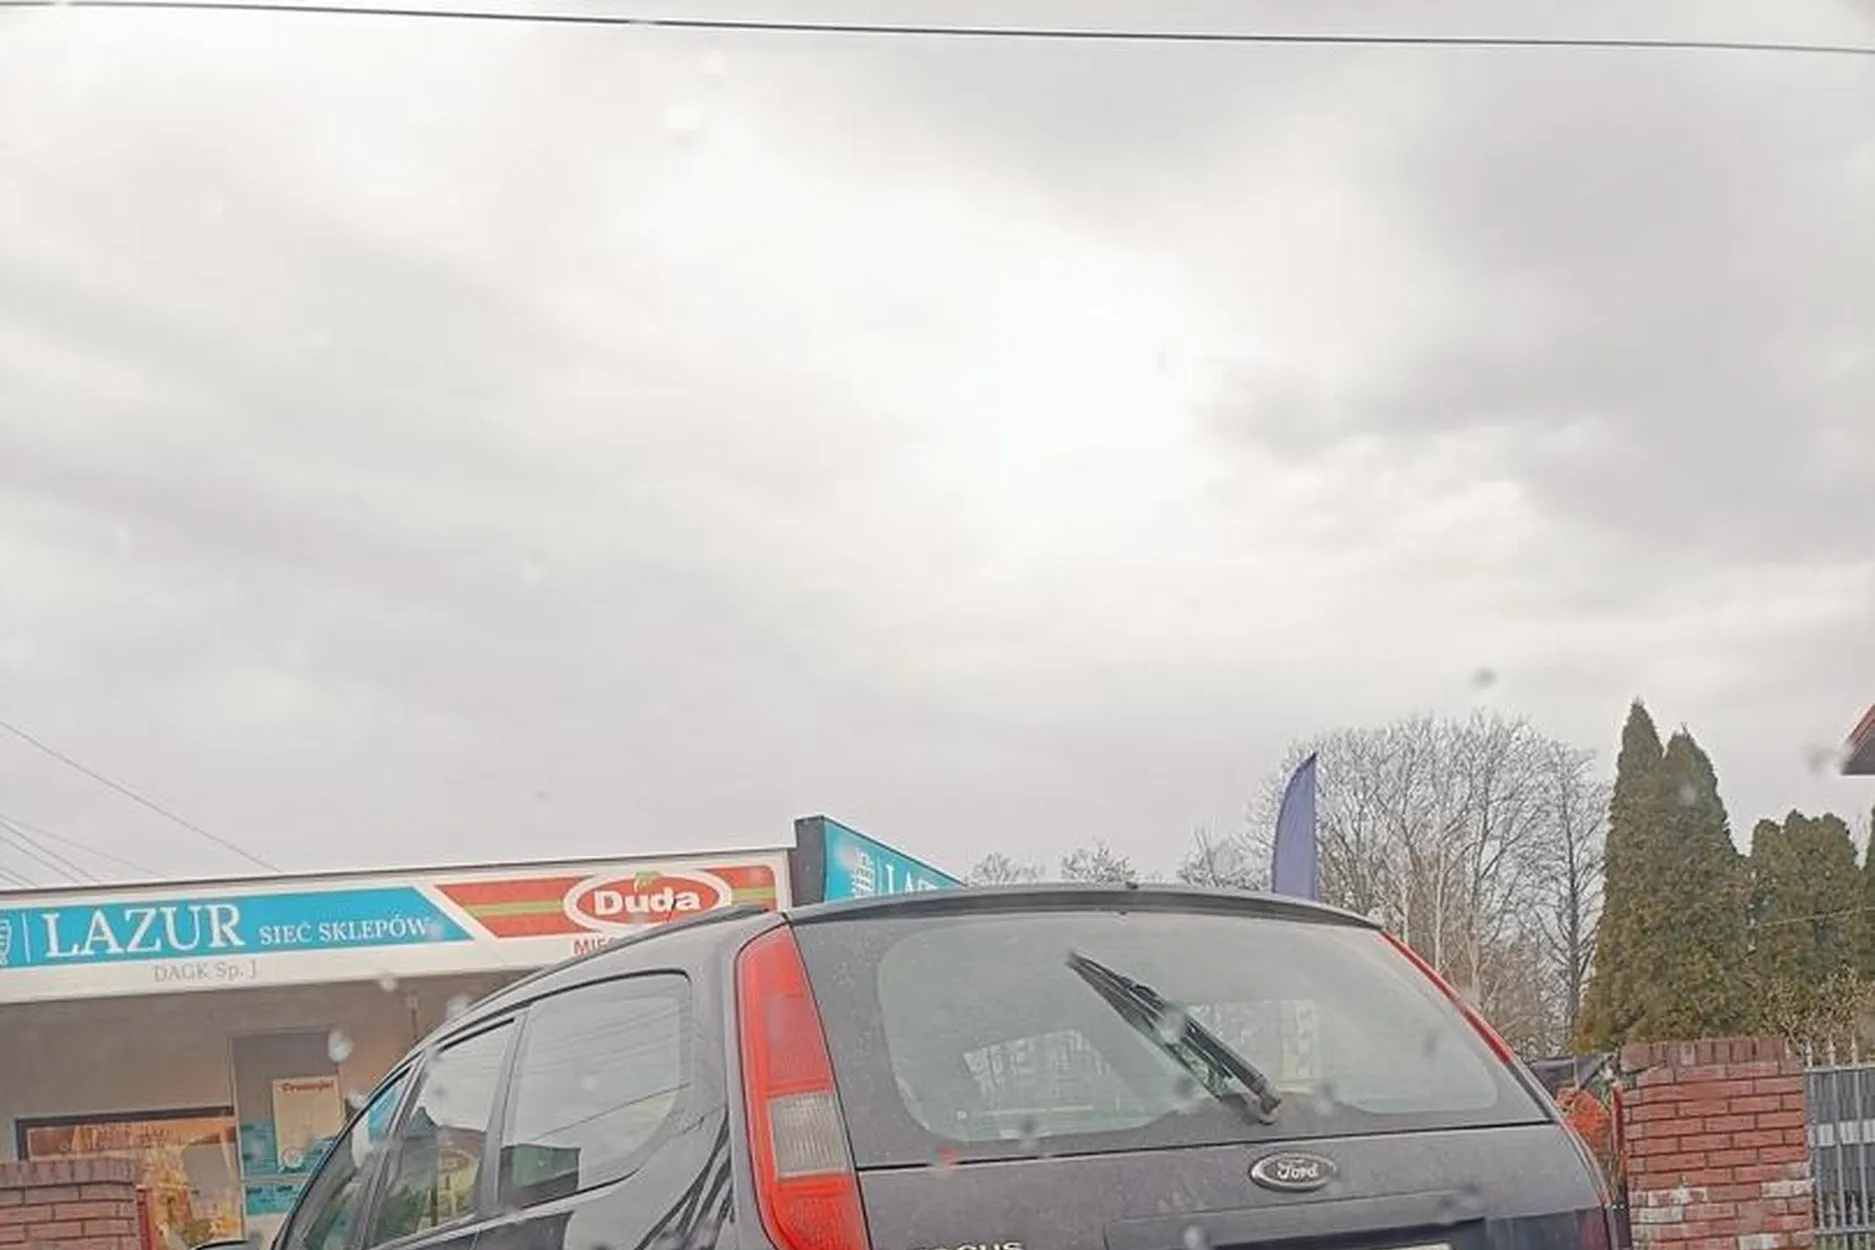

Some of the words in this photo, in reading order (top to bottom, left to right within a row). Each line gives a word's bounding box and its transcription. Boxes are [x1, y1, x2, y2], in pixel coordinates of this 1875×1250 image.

[594, 886, 700, 916] Duda
[41, 903, 246, 958] LAZUR
[259, 922, 311, 945] SIEĆ
[318, 914, 430, 942] SKLEPÓW
[1277, 1159, 1319, 1180] Ford
